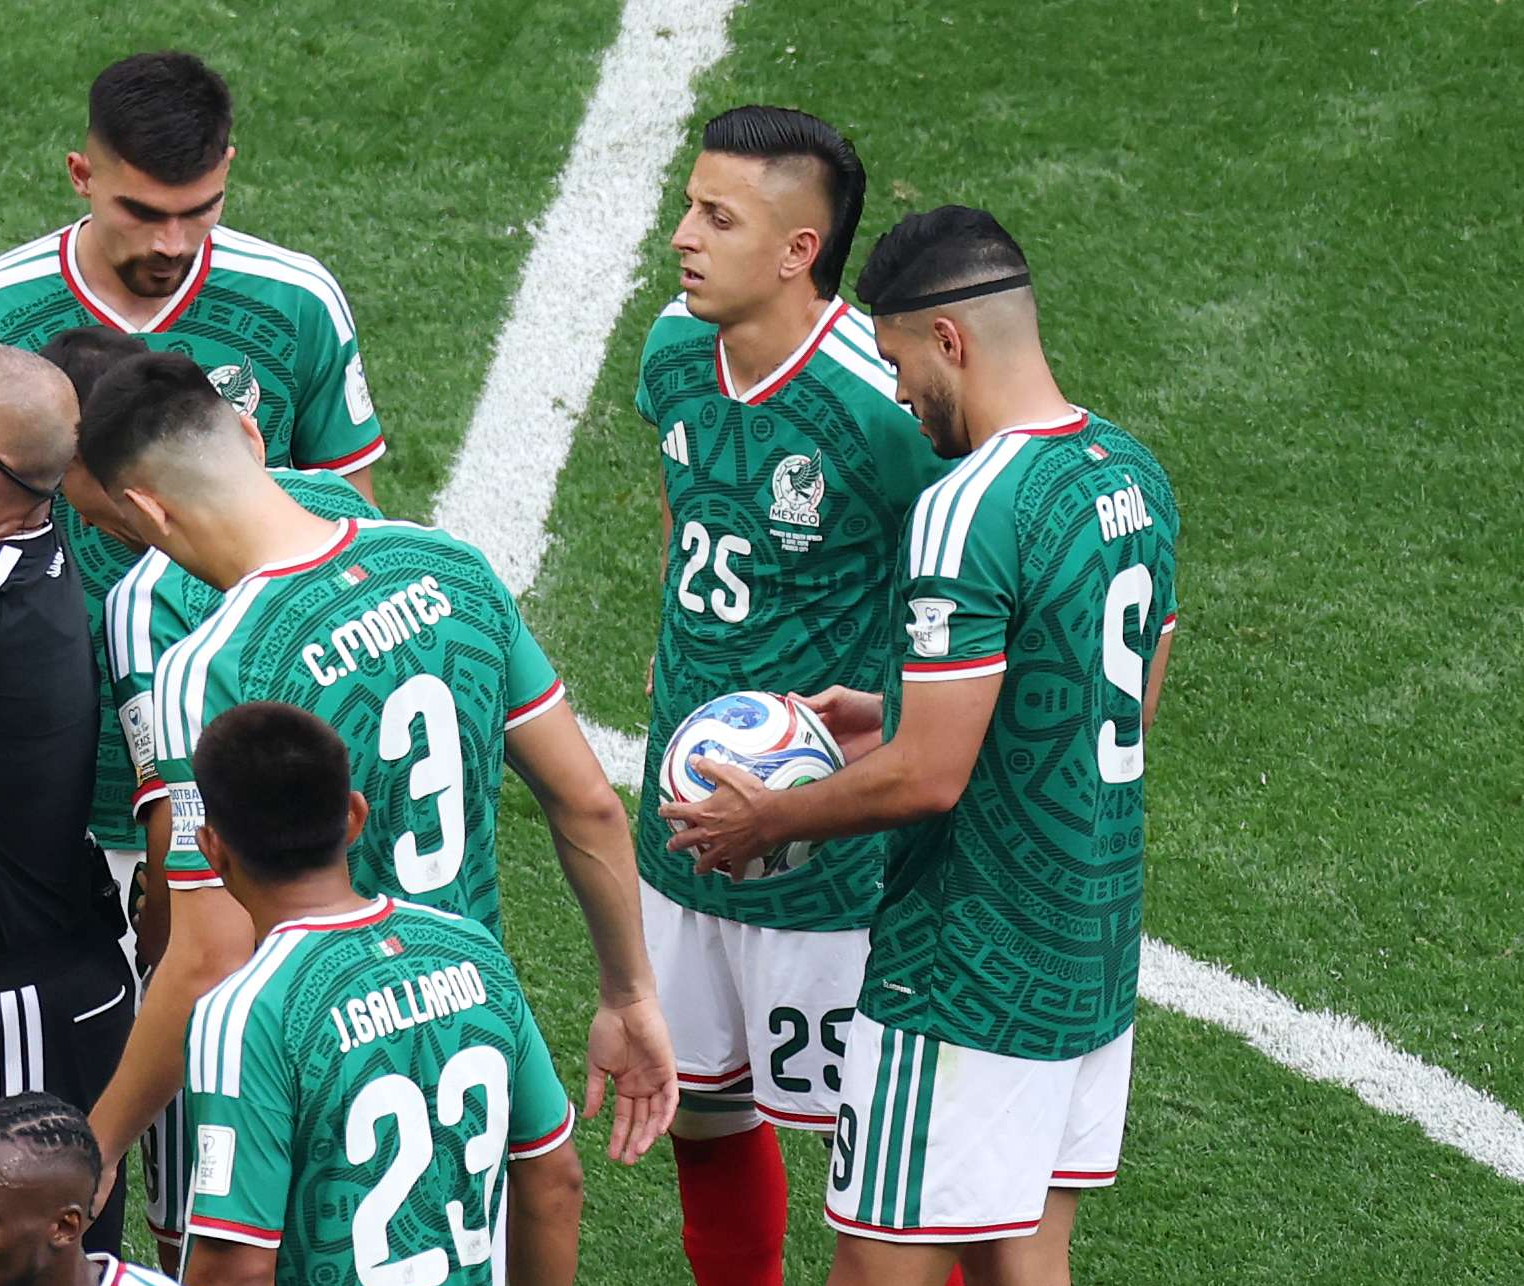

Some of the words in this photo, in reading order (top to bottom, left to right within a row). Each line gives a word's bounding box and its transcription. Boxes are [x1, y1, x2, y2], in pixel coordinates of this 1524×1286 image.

[1096, 474, 1153, 542] RAÚL
[679, 521, 751, 623] 25
[302, 575, 452, 687] C.MONTES
[173, 801, 205, 817] NITE
[379, 673, 466, 894] 3
[331, 961, 487, 1052] J.GALLARDO
[832, 1103, 858, 1192] 9
